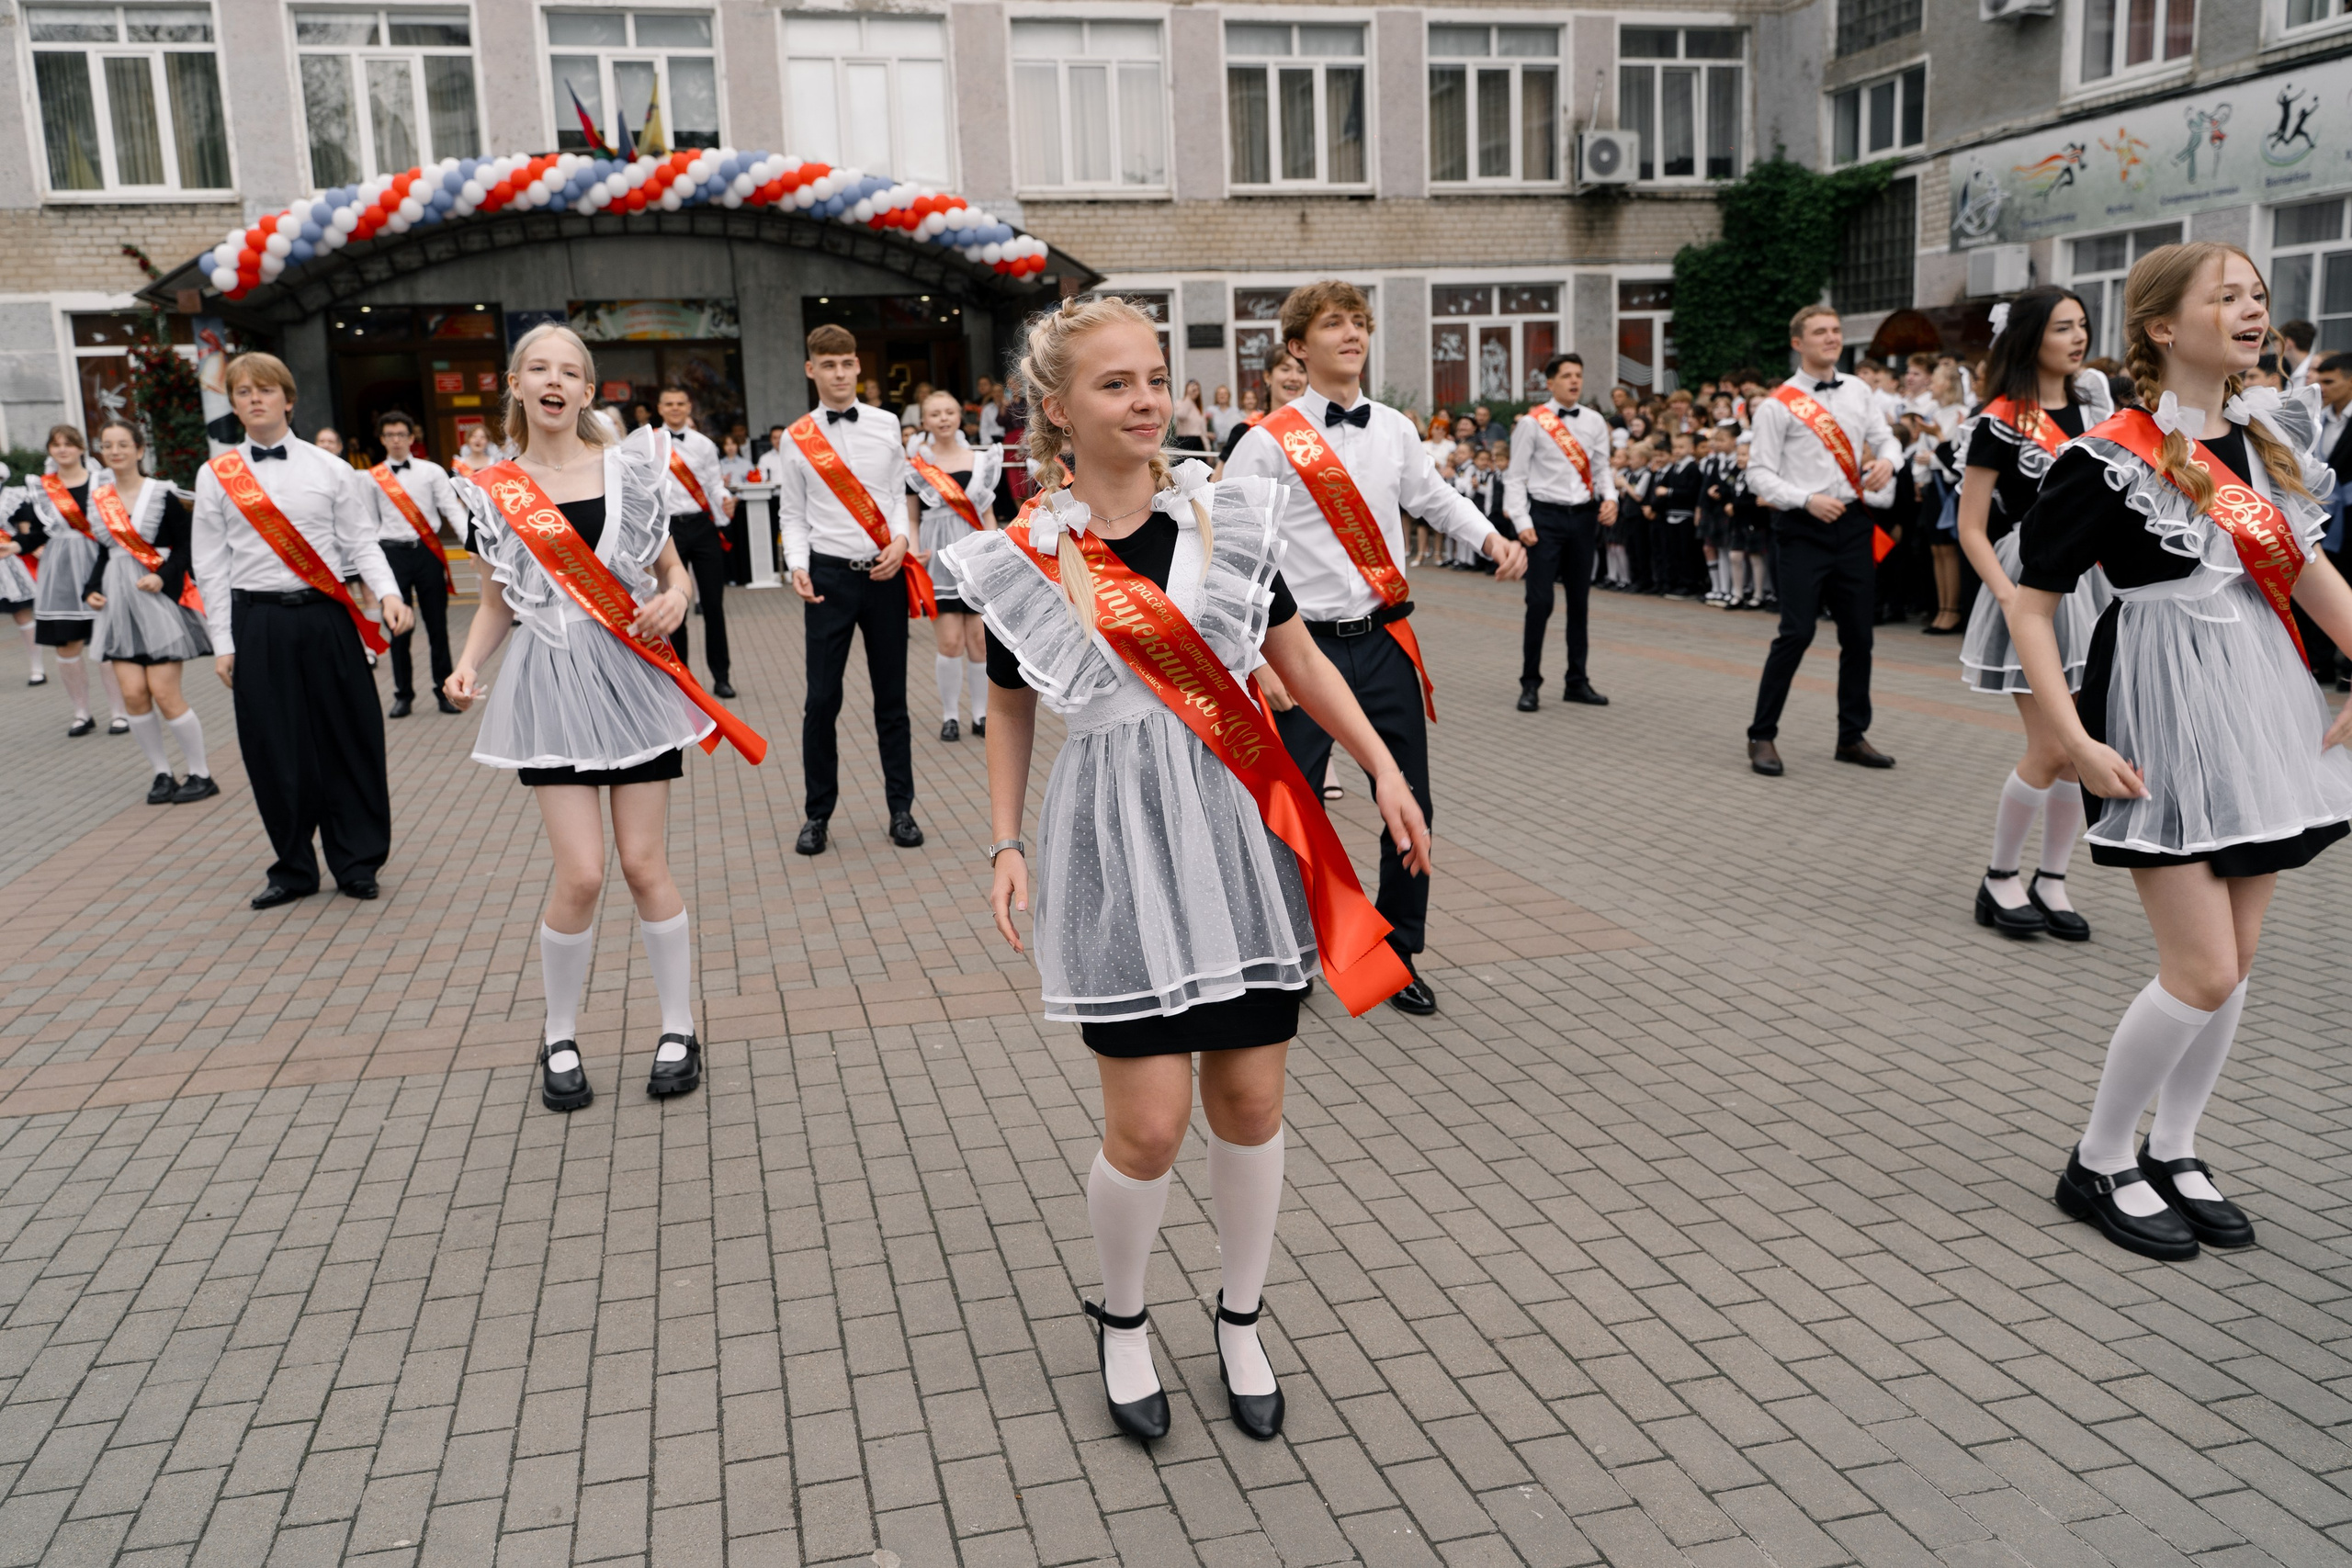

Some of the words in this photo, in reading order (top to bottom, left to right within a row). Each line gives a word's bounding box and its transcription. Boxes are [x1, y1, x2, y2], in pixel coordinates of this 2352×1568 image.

[1317, 466, 1386, 579] Выпускник
[1119, 638, 1164, 695] Новороссийск
[1170, 623, 1230, 693] Екатерина
[1210, 709, 1276, 770] 2026
